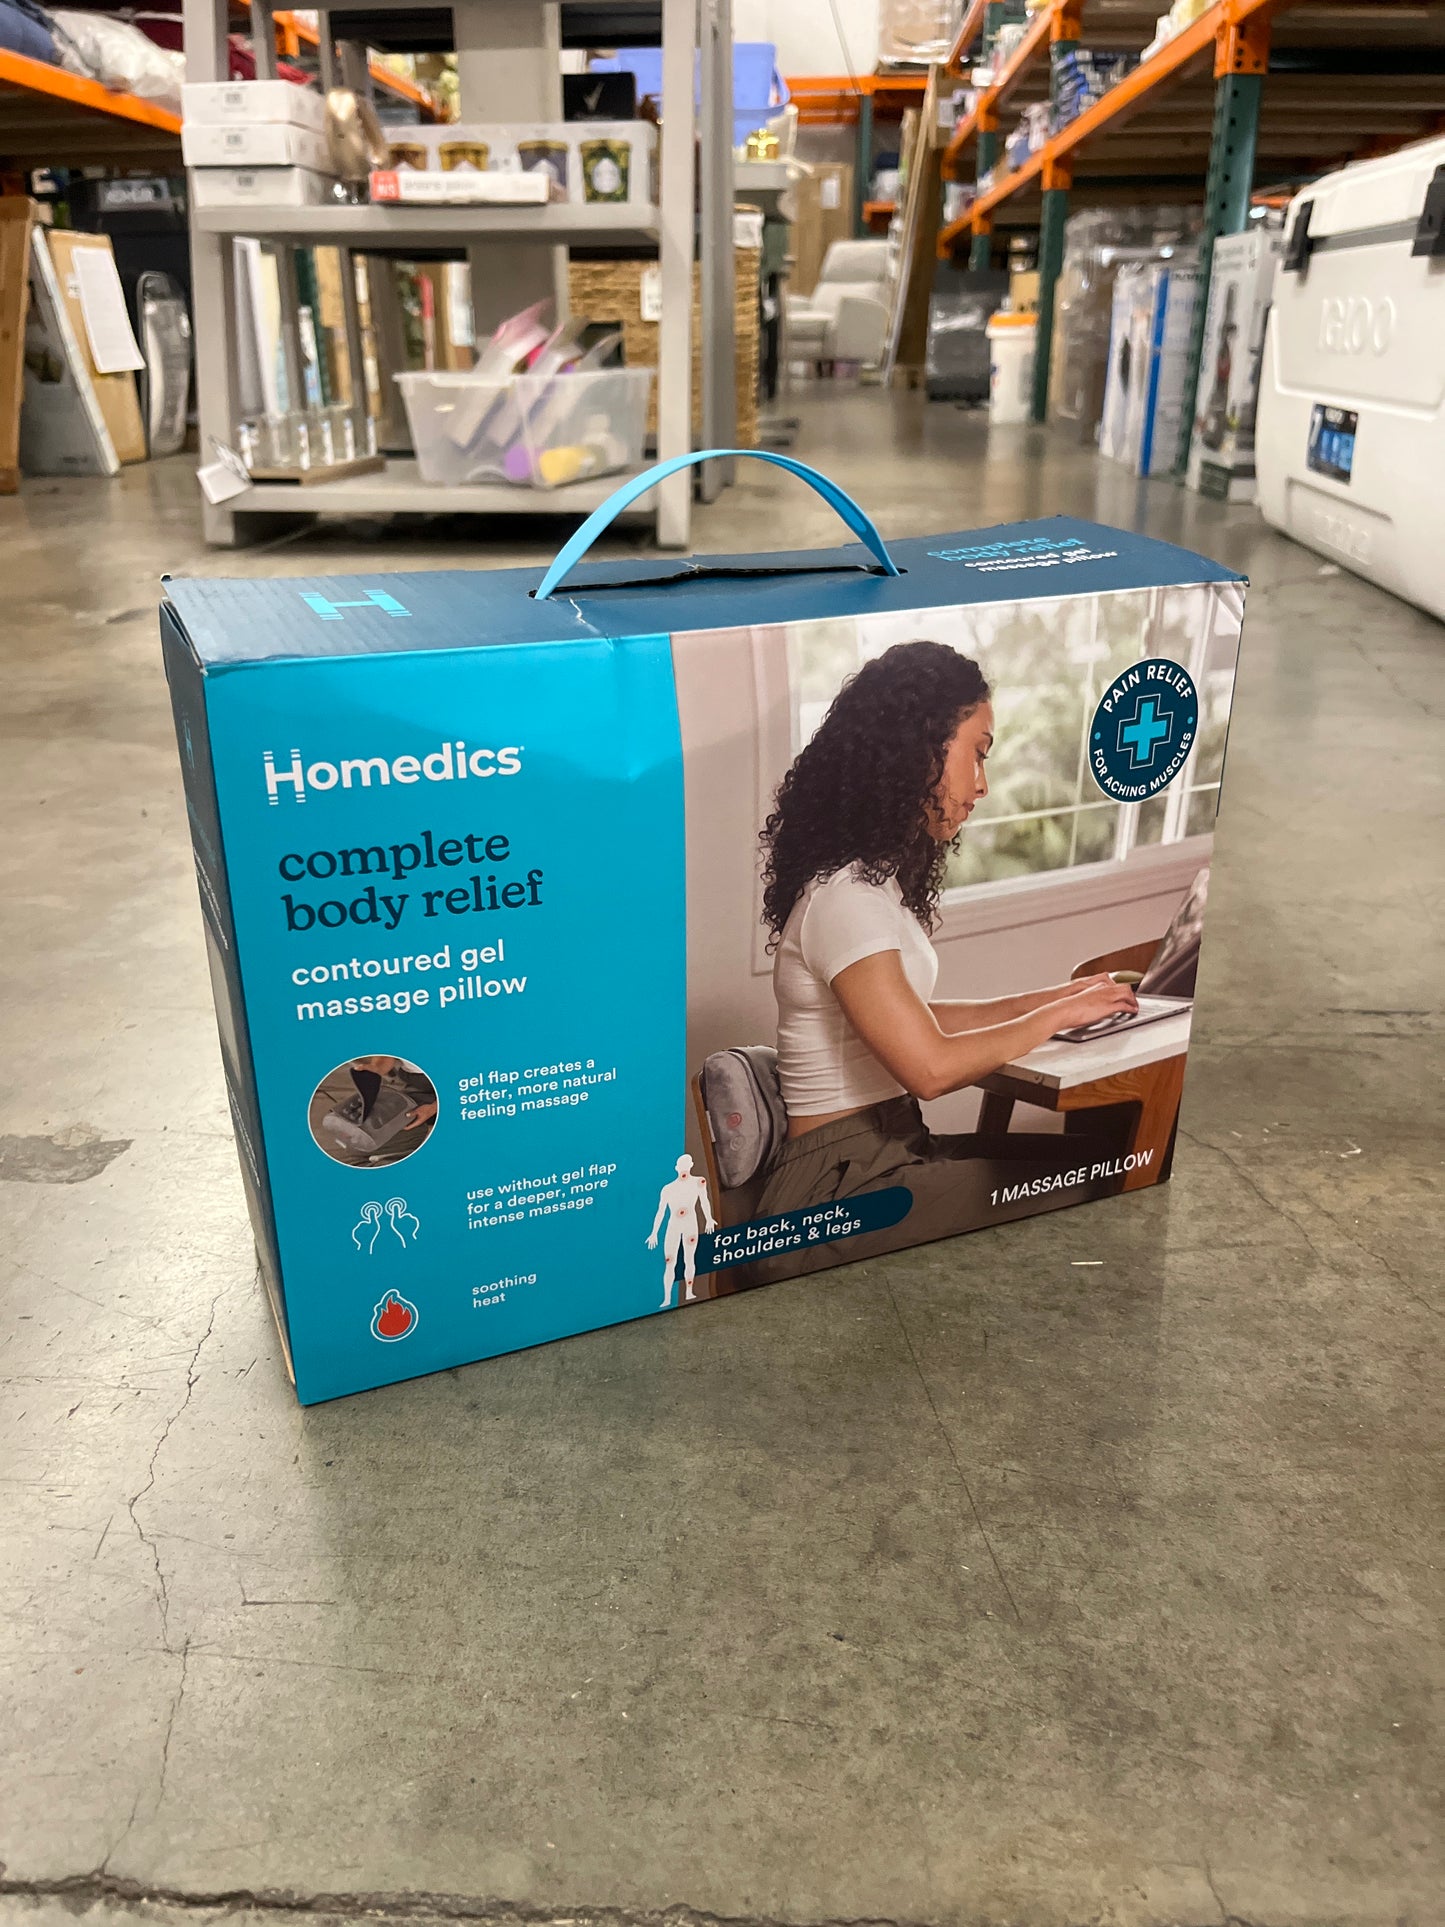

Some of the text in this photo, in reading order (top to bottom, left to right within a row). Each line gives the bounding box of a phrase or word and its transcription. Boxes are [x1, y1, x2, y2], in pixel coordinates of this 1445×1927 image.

[926, 536, 1051, 559] complete
[939, 536, 1087, 563] body relief
[964, 547, 1093, 568] contoured gel
[977, 551, 1118, 573] massage pillow
[1102, 664, 1193, 713] PAIN RELIEF
[263, 740, 525, 806] Homedics
[1093, 731, 1192, 798] FOR ACHING MUSCLES
[278, 830, 510, 882] complete
[279, 886, 410, 932] body
[420, 869, 544, 919] relief
[291, 938, 505, 986] contoured gel
[296, 975, 529, 1021] massage pillow
[458, 1059, 595, 1092] gel flap creates a
[459, 1067, 617, 1105] softer, more natural
[460, 1091, 589, 1121] feeling massage
[466, 1163, 617, 1200] use without gel flap
[990, 1148, 1154, 1206] 1 MASSAGE PILLOW
[467, 1179, 609, 1215] for a deeper, more
[468, 1196, 594, 1230] intense massage
[712, 1218, 862, 1265] shoulders & legs
[713, 1205, 850, 1248] for back, neck,
[472, 1273, 537, 1296] soothing
[473, 1292, 506, 1308] heat
